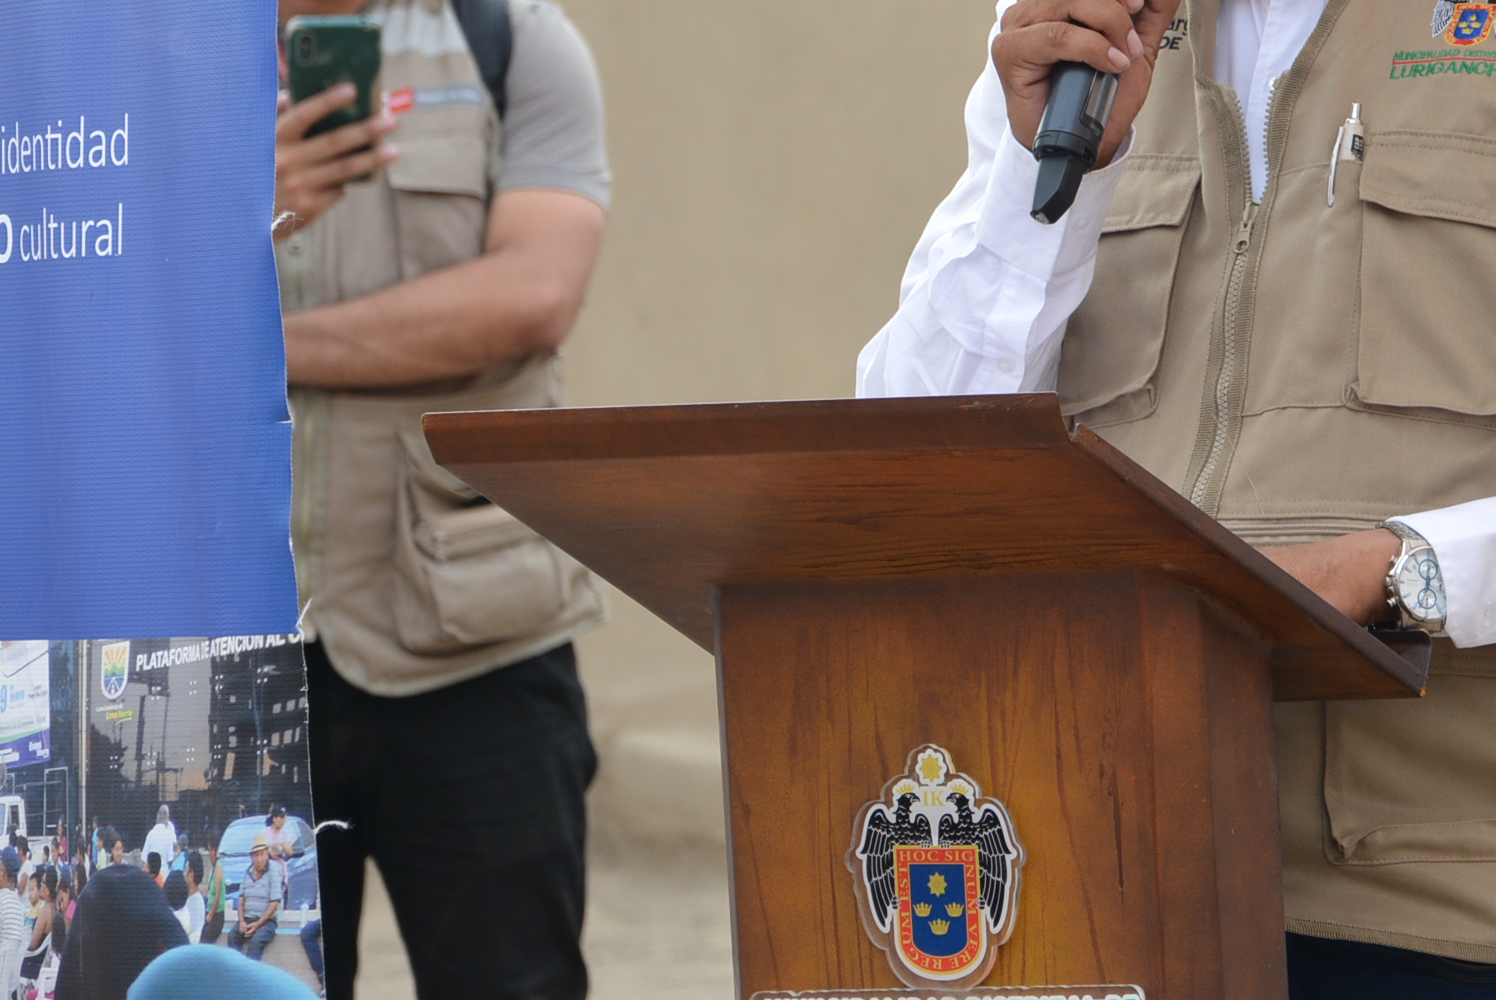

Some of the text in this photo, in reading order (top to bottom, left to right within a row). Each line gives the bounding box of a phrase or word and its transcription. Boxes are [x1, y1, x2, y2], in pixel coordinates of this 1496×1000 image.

[1, 113, 129, 175] identidad
[20, 203, 123, 262] cultural
[136, 642, 200, 672] PLATAFORMA
[922, 790, 945, 807] IK
[900, 850, 939, 862] HOC
[898, 862, 909, 901] EST
